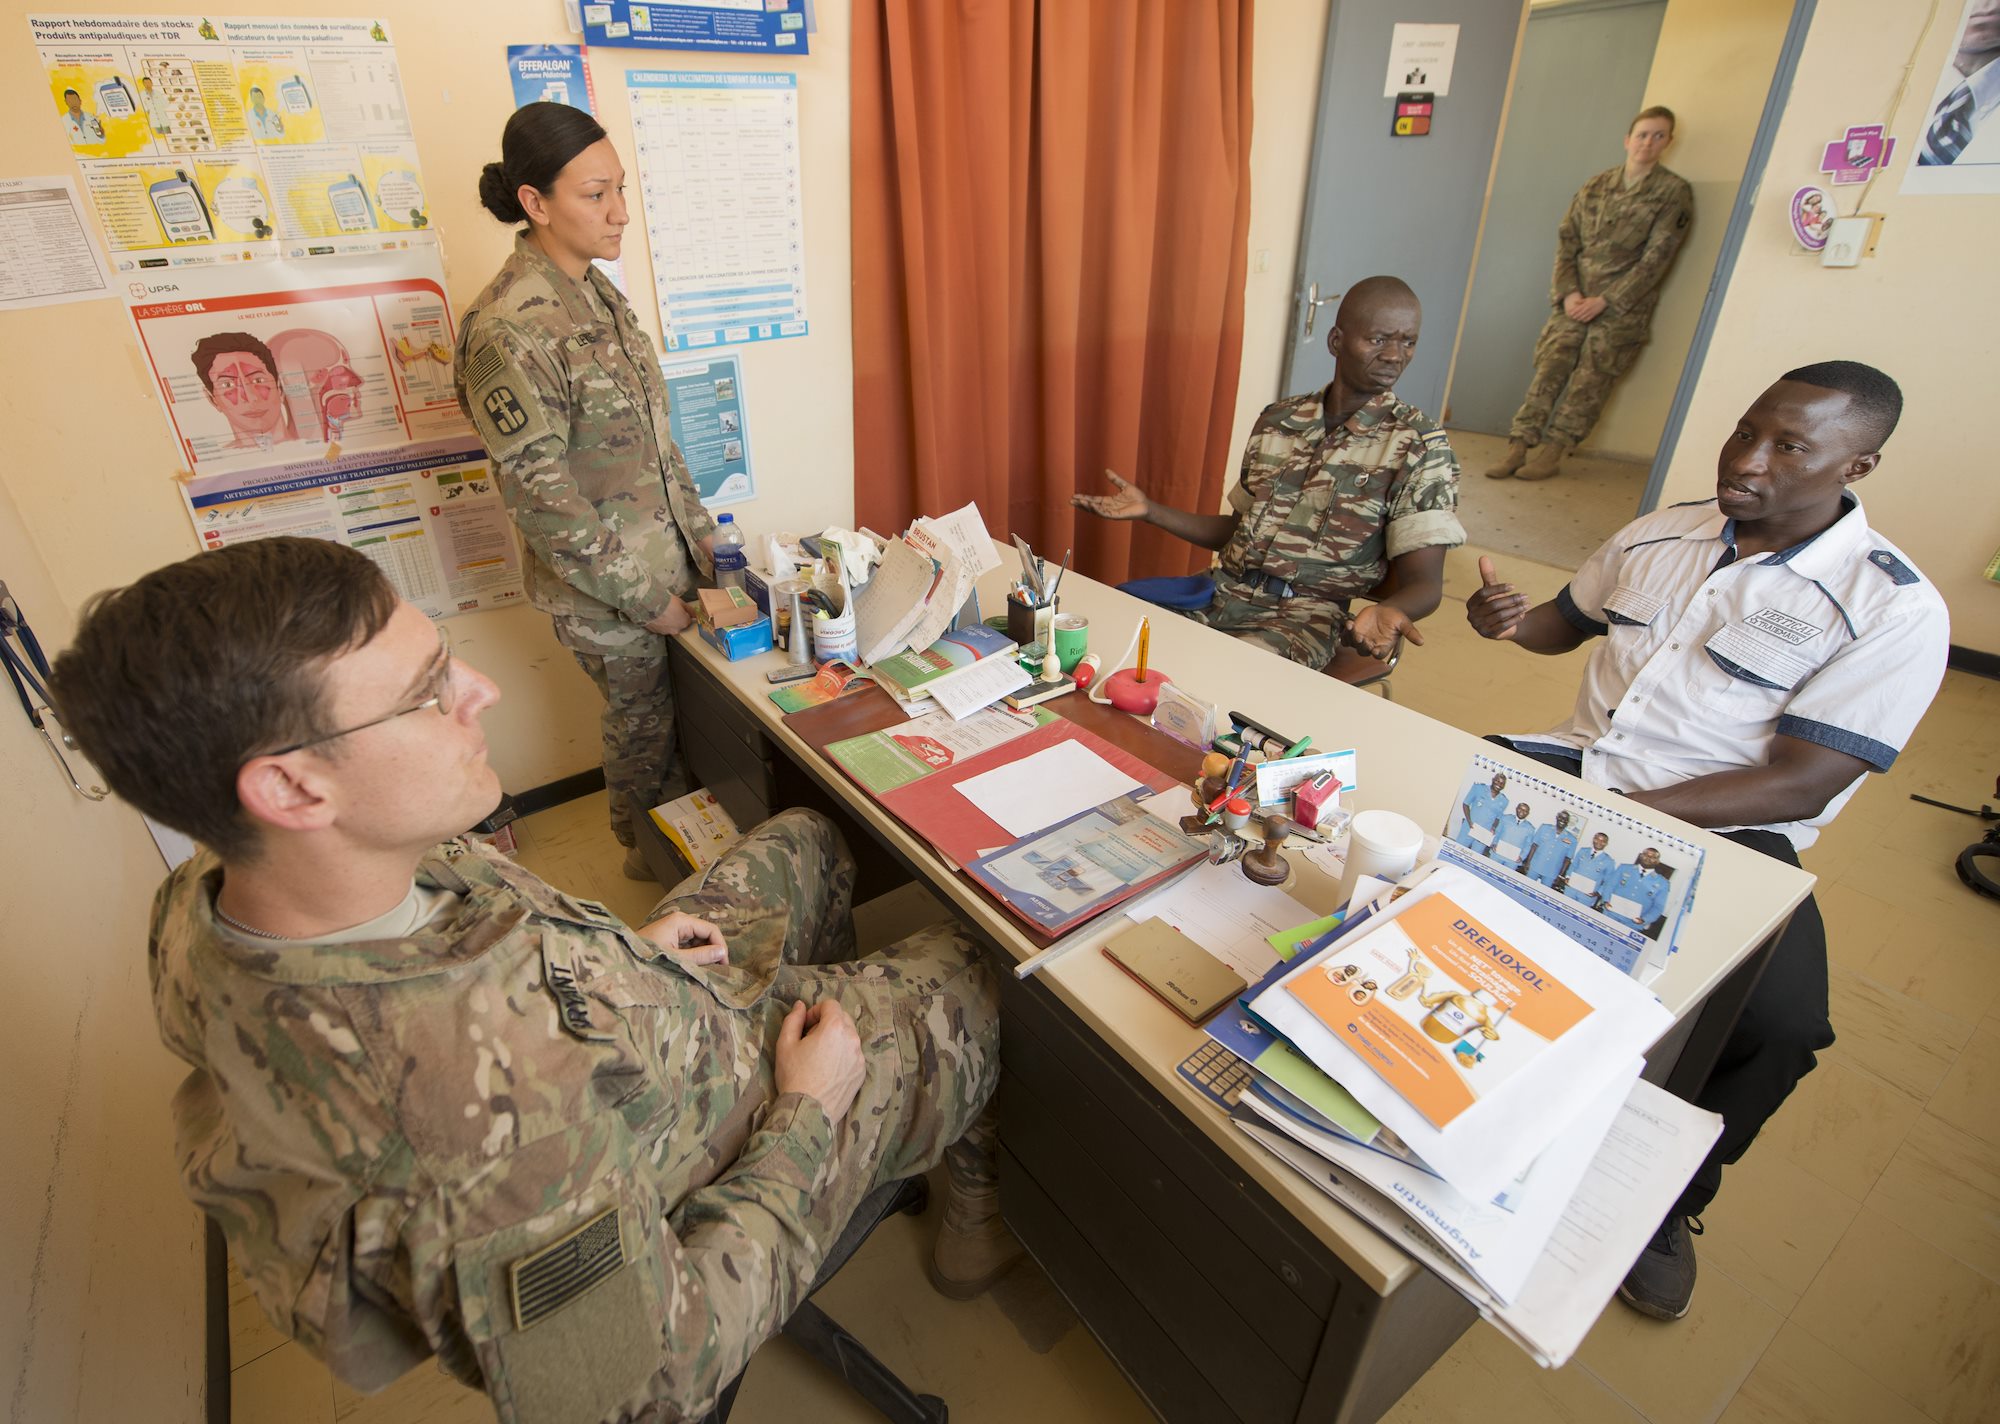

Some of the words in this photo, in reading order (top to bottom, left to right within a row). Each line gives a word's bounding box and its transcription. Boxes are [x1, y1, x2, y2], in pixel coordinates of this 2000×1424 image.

[31, 19, 71, 29] Rapport
[73, 19, 140, 28] hebdomadaire
[142, 20, 159, 28] des
[224, 22, 251, 31] Rapport
[35, 31, 76, 40] Produits
[78, 31, 147, 41] antipaludiques
[150, 32, 159, 40] et
[161, 32, 181, 40] TDR
[518, 60, 570, 71] EFFERALGAN
[670, 74, 676, 82] DE
[677, 74, 715, 83] VACCINATION
[148, 284, 180, 294] UPSA
[137, 308, 150, 318] LA
[150, 303, 185, 316] SPHÈRE
[185, 302, 206, 312] ORL
[223, 487, 274, 500] ARTESUNATE
[275, 478, 318, 492] INJECTABLE
[318, 474, 338, 484] POUR
[338, 472, 349, 480] LE
[350, 466, 396, 479] TRAITEMENT
[408, 458, 445, 470] PALUDISME
[446, 454, 468, 463] GRAVE
[242, 473, 292, 486] PROGRAMME
[294, 466, 332, 478] NATIONAL
[370, 456, 398, 467] CONTRE
[912, 527, 937, 550] BRUSTAN
[1762, 610, 1815, 636] VERTICAL
[1759, 620, 1800, 643] TRADEMARK
[1029, 896, 1052, 912] AERIUS
[1572, 930, 1582, 938] 13
[1588, 938, 1597, 946] 14
[1604, 946, 1614, 955] 15
[1632, 932, 1644, 942] 04
[1453, 919, 1543, 992] DRENOXOL
[1393, 1182, 1482, 1259] Augmentin
